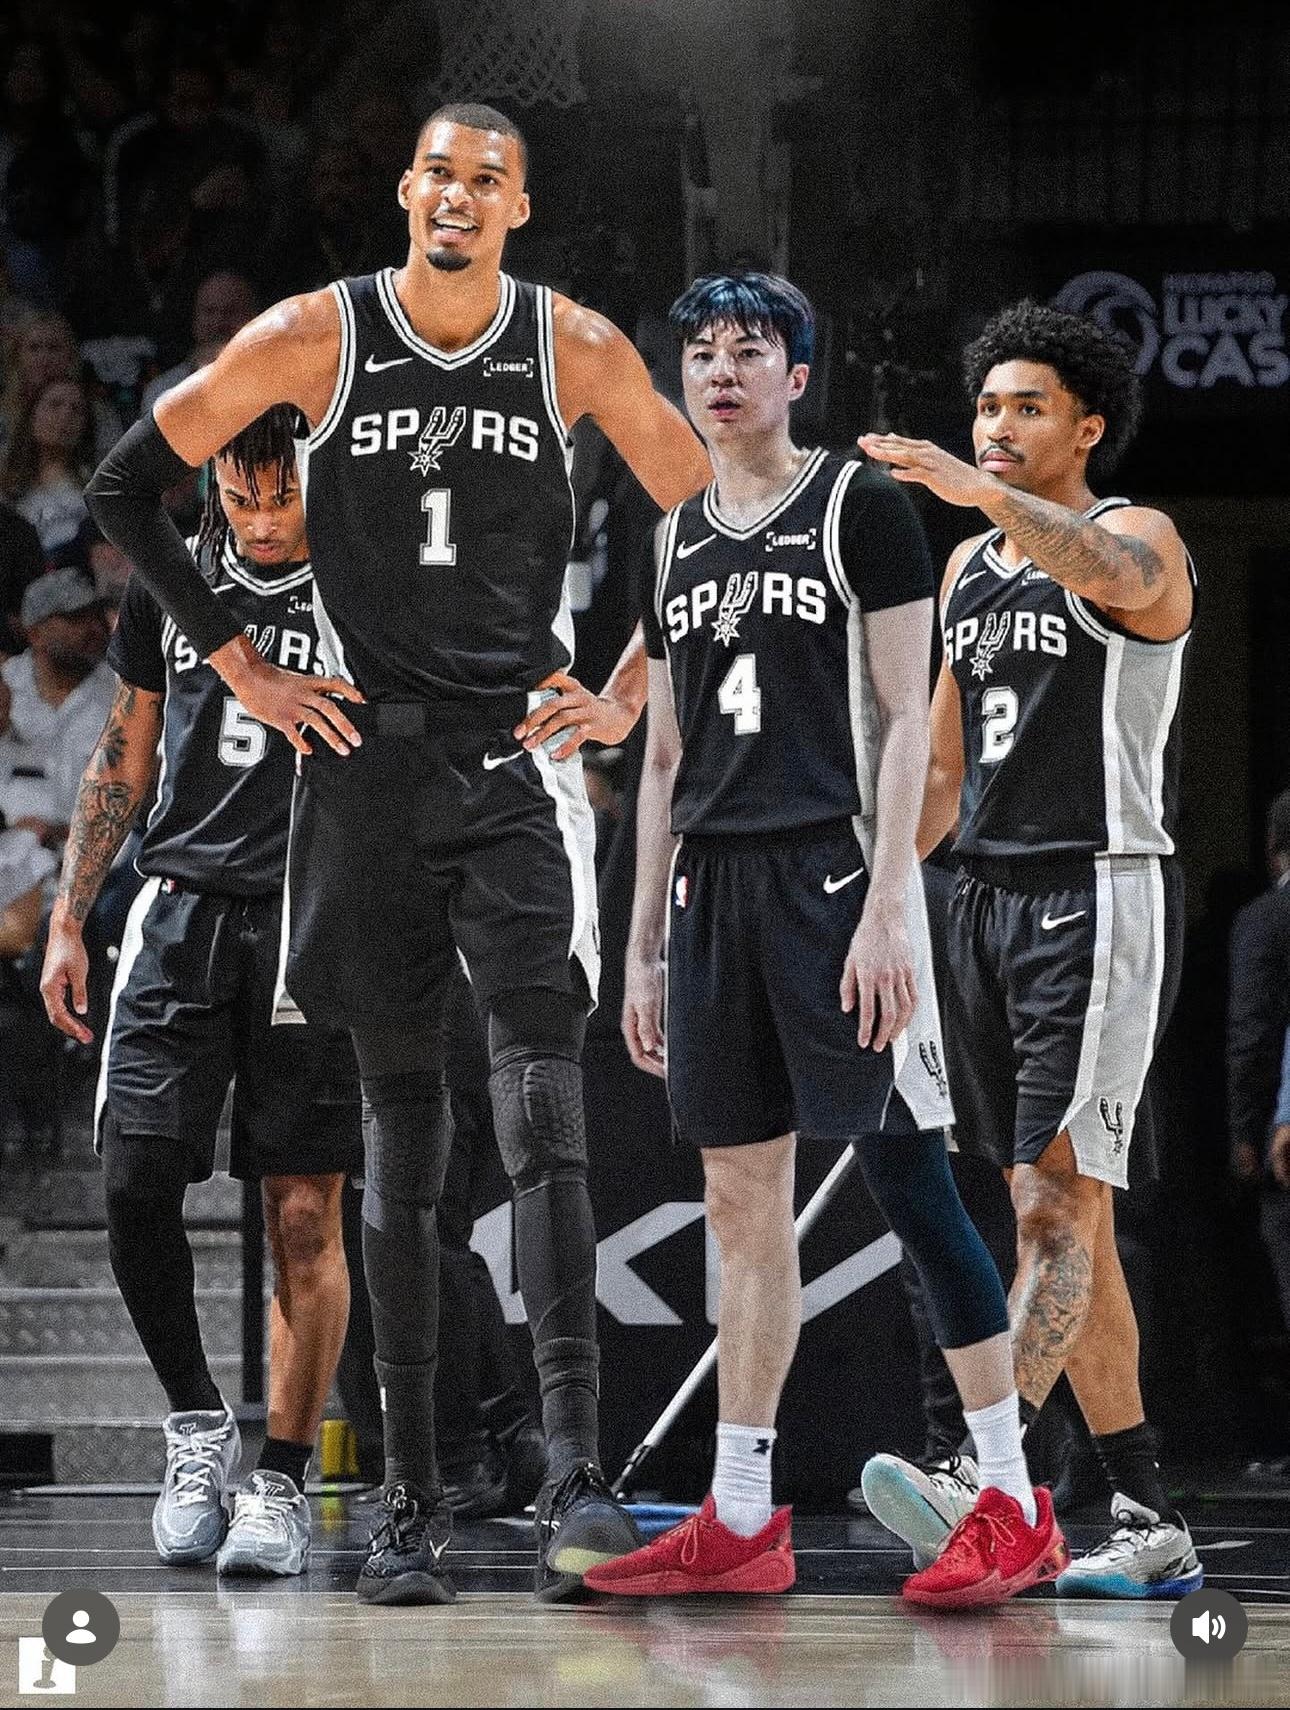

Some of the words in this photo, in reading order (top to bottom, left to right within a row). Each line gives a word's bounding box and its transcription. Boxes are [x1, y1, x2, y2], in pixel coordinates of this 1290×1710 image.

[1161, 334, 1289, 388] CAS
[350, 406, 540, 477] SPURS
[419, 488, 457, 566] 1
[665, 571, 827, 647] SPURS
[217, 696, 267, 767] 5
[717, 653, 761, 736] 4
[979, 686, 1019, 763] 2
